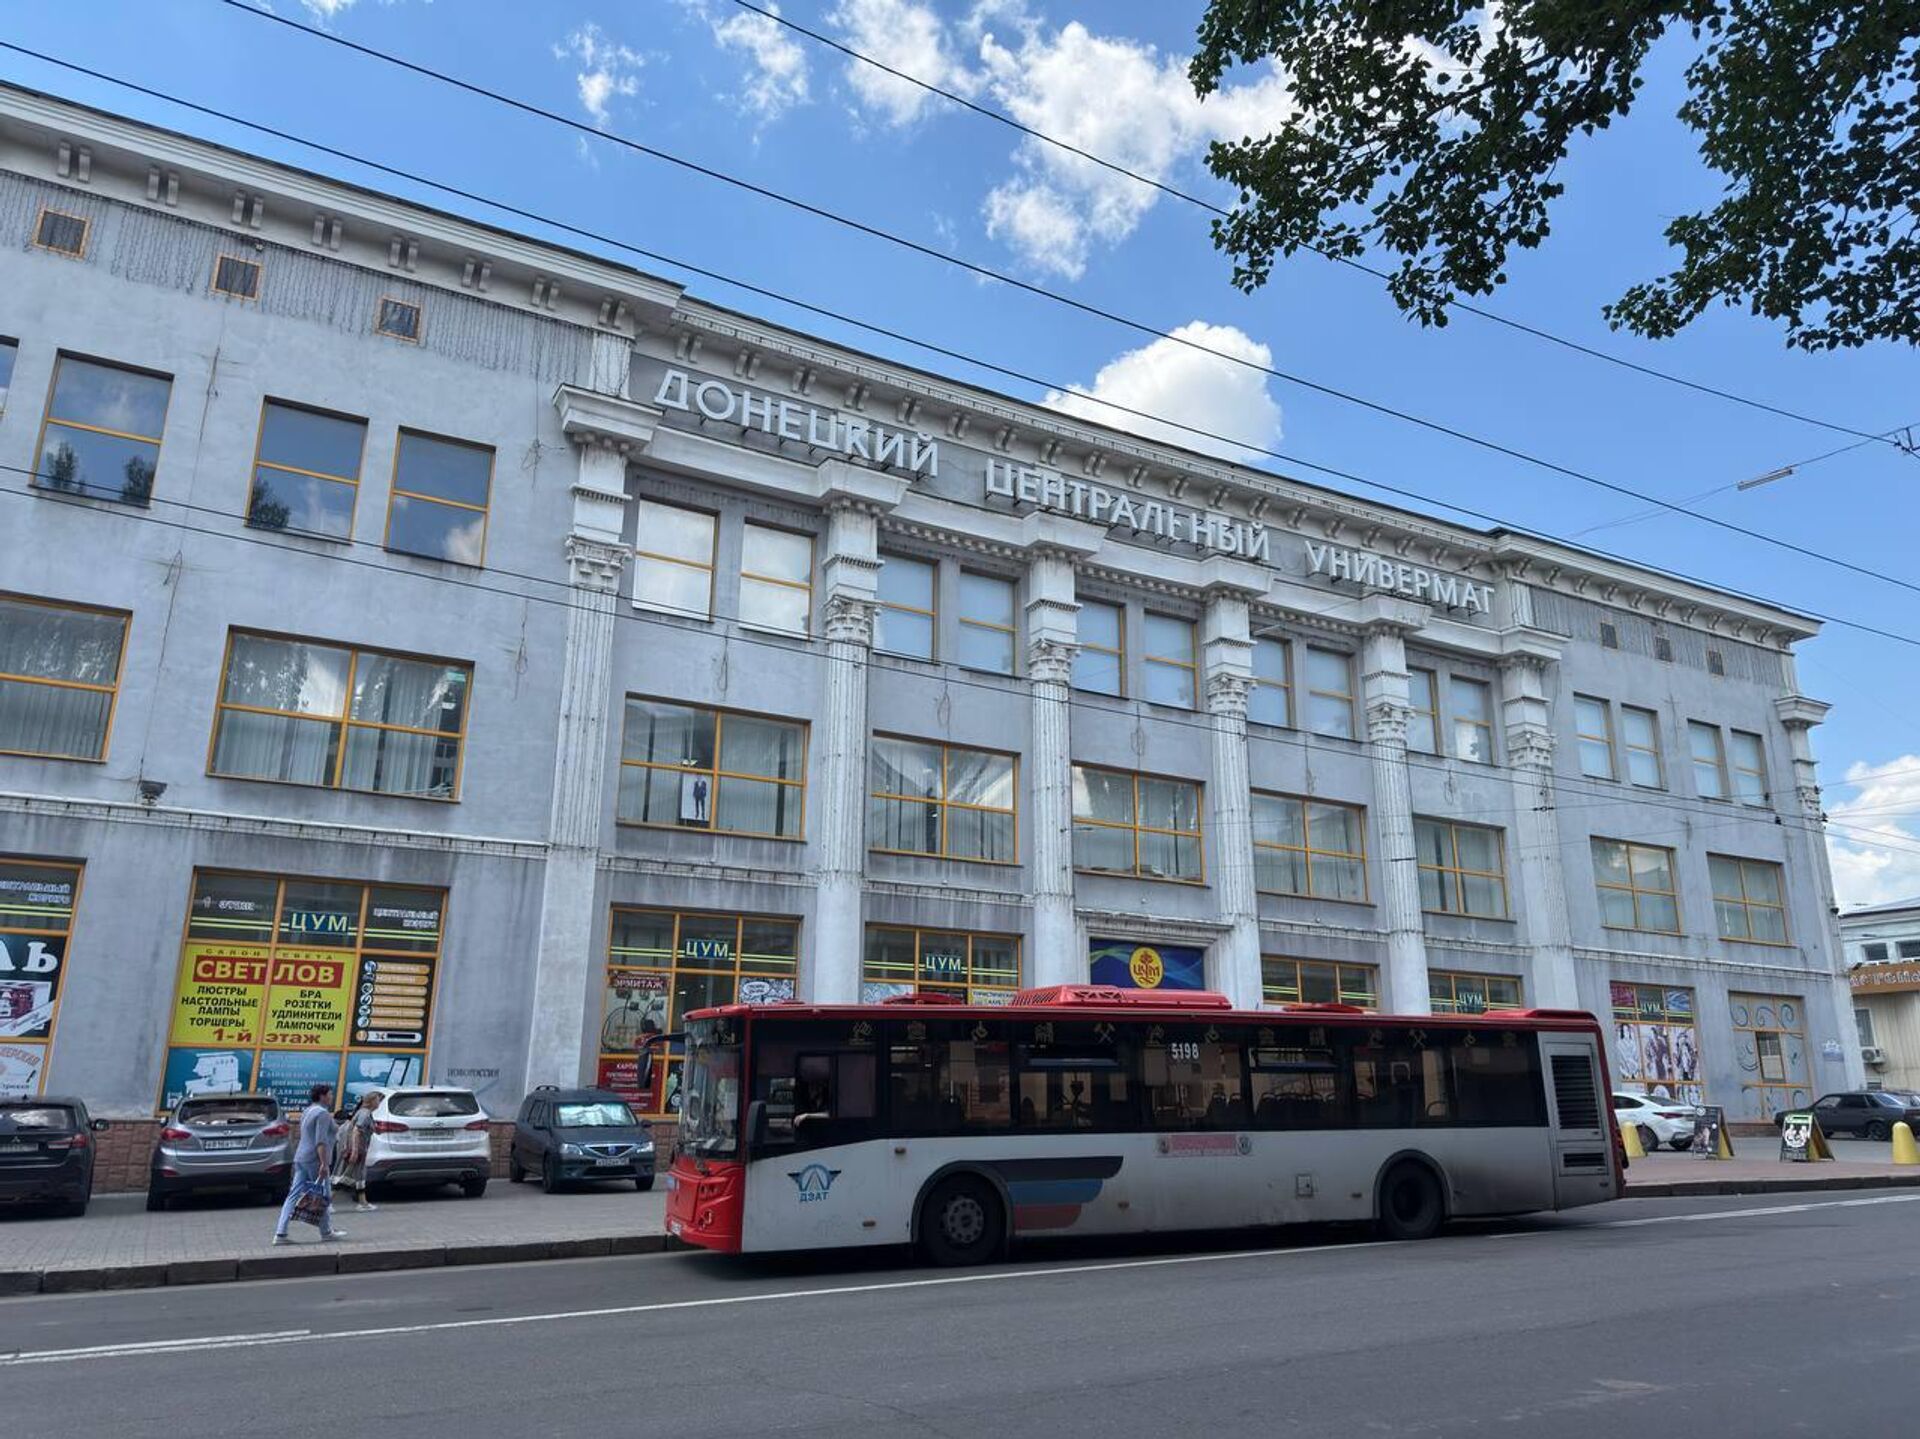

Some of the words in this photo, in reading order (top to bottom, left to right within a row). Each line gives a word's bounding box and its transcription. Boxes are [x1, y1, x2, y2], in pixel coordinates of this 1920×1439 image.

[654, 369, 939, 477] ДОНЕЦКИЙ
[984, 457, 1270, 561] ЦЕНТРАЛЬНЫЙ
[1304, 540, 1495, 614] УНИВЕРМАГ
[292, 912, 348, 932] ЦУМ
[685, 940, 729, 958] ЦУМ
[925, 956, 961, 972] ЦУМ
[197, 985, 247, 995] ЛЮСТРЫ
[300, 989, 322, 999] БРА
[181, 996, 259, 1008] НАСТОЛЬНЫЕ
[284, 999, 332, 1010] РОЗЕТКИ
[198, 1006, 240, 1016] ЛАМПЫ
[271, 1009, 342, 1021] УДЛИНИТЕЛИ
[189, 1017, 246, 1028] ТОРШЕРЫ
[276, 1020, 336, 1031] ЛАМПОЧКИ
[213, 1028, 252, 1042] 1-й
[265, 1032, 321, 1044] этаж
[1170, 1042, 1200, 1060] 5198
